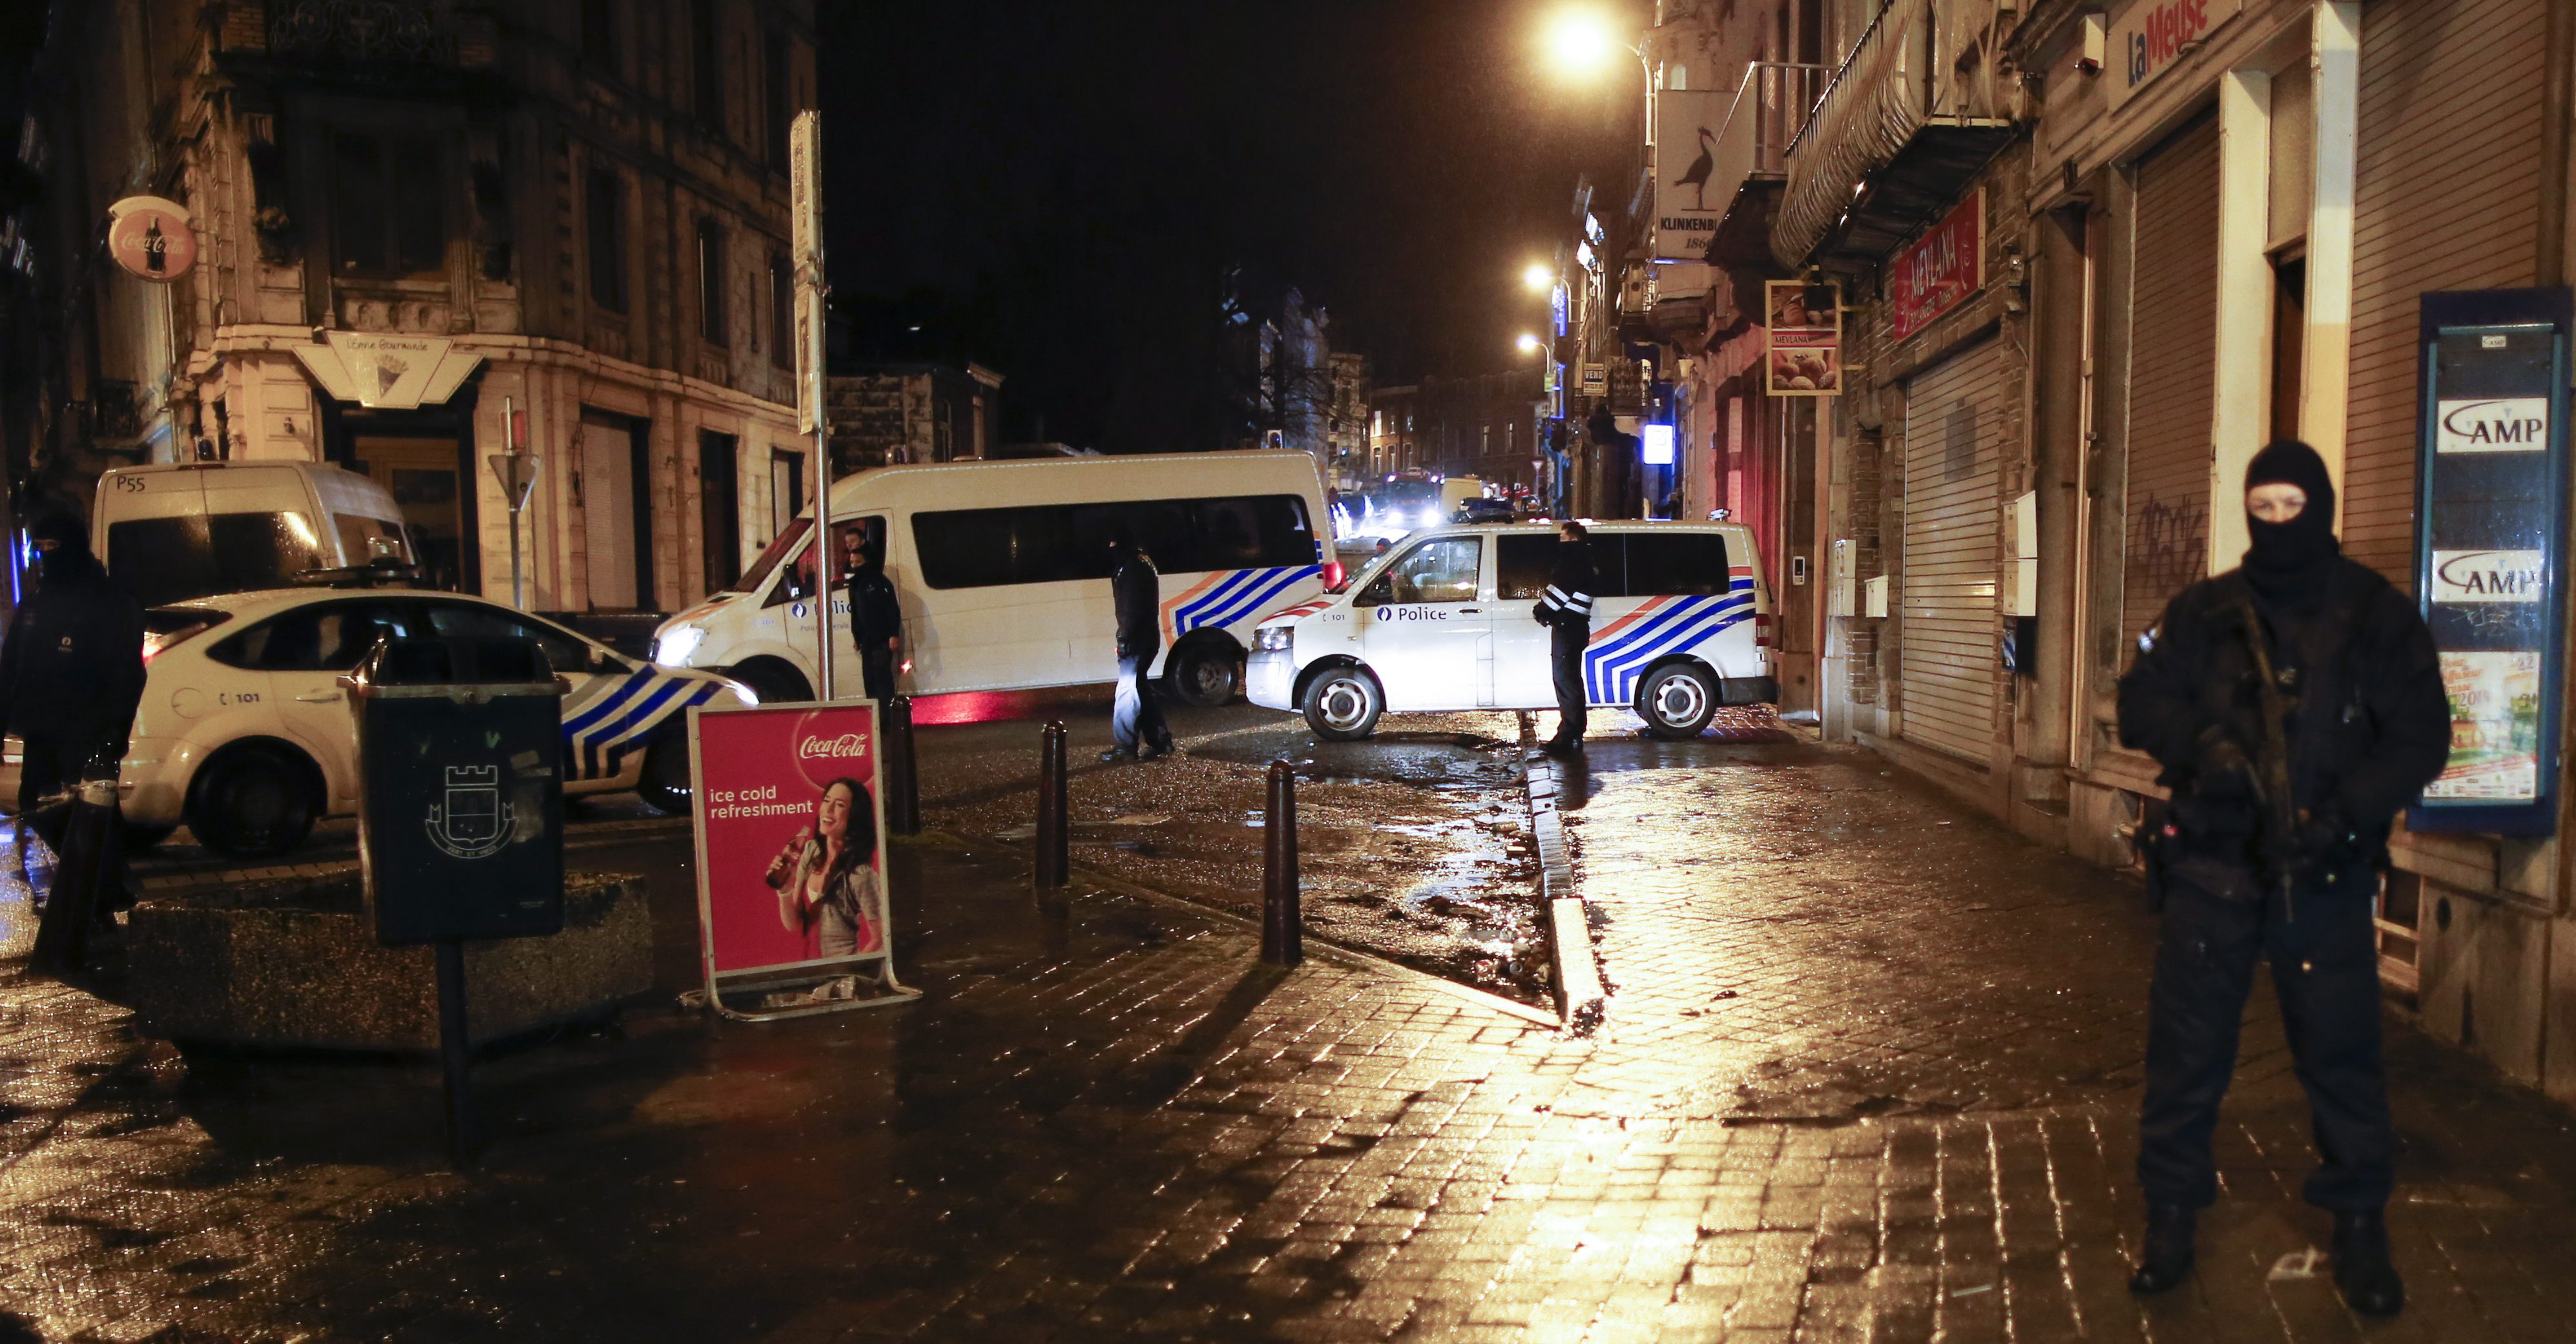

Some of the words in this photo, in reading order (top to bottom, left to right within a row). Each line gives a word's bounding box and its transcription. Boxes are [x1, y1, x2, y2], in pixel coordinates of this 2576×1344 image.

[1911, 223, 1957, 301] MEVLANA
[117, 475, 145, 492] P55
[1399, 606, 1447, 621] Police
[235, 693, 260, 703] 101
[800, 734, 868, 759] Coca-Cola
[710, 789, 735, 803] ice
[741, 785, 776, 801] cold
[711, 800, 813, 819] refreshment
